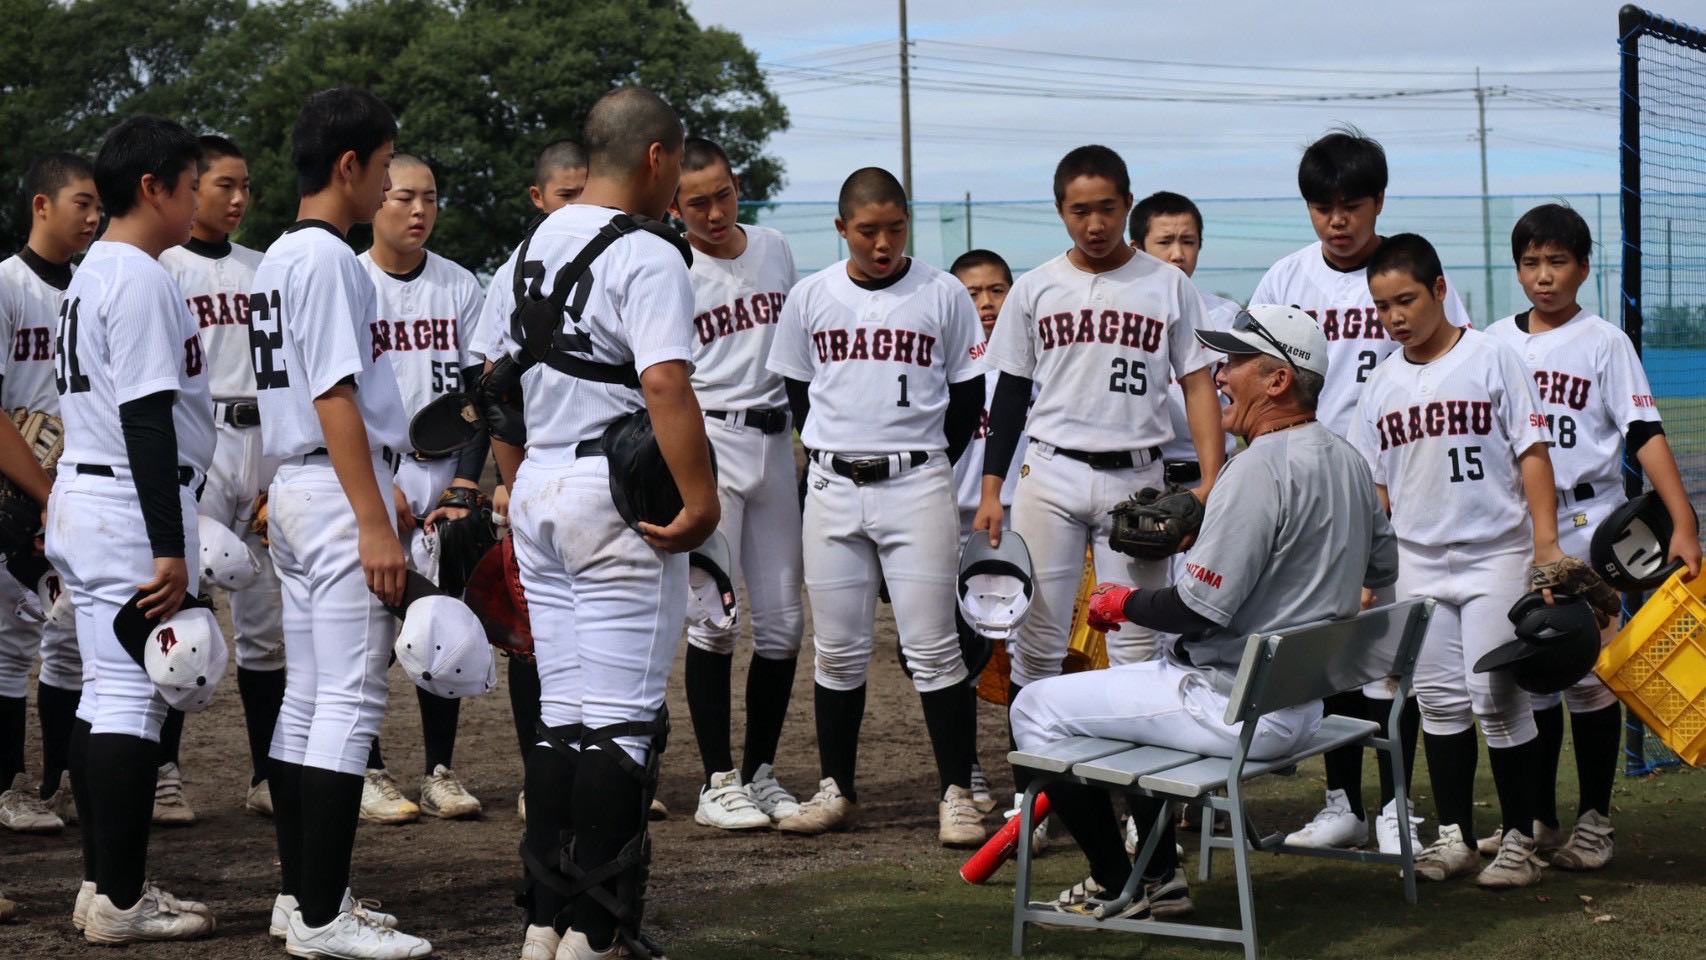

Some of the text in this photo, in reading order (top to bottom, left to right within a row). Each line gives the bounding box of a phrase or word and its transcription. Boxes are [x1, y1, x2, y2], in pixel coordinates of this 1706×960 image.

[693, 291, 787, 346] URACH
[431, 360, 461, 393] 55
[1109, 357, 1148, 396] 25
[1356, 350, 1390, 383] 2
[896, 374, 910, 407] 1
[1546, 414, 1577, 449] 18
[1448, 446, 1484, 483] 15
